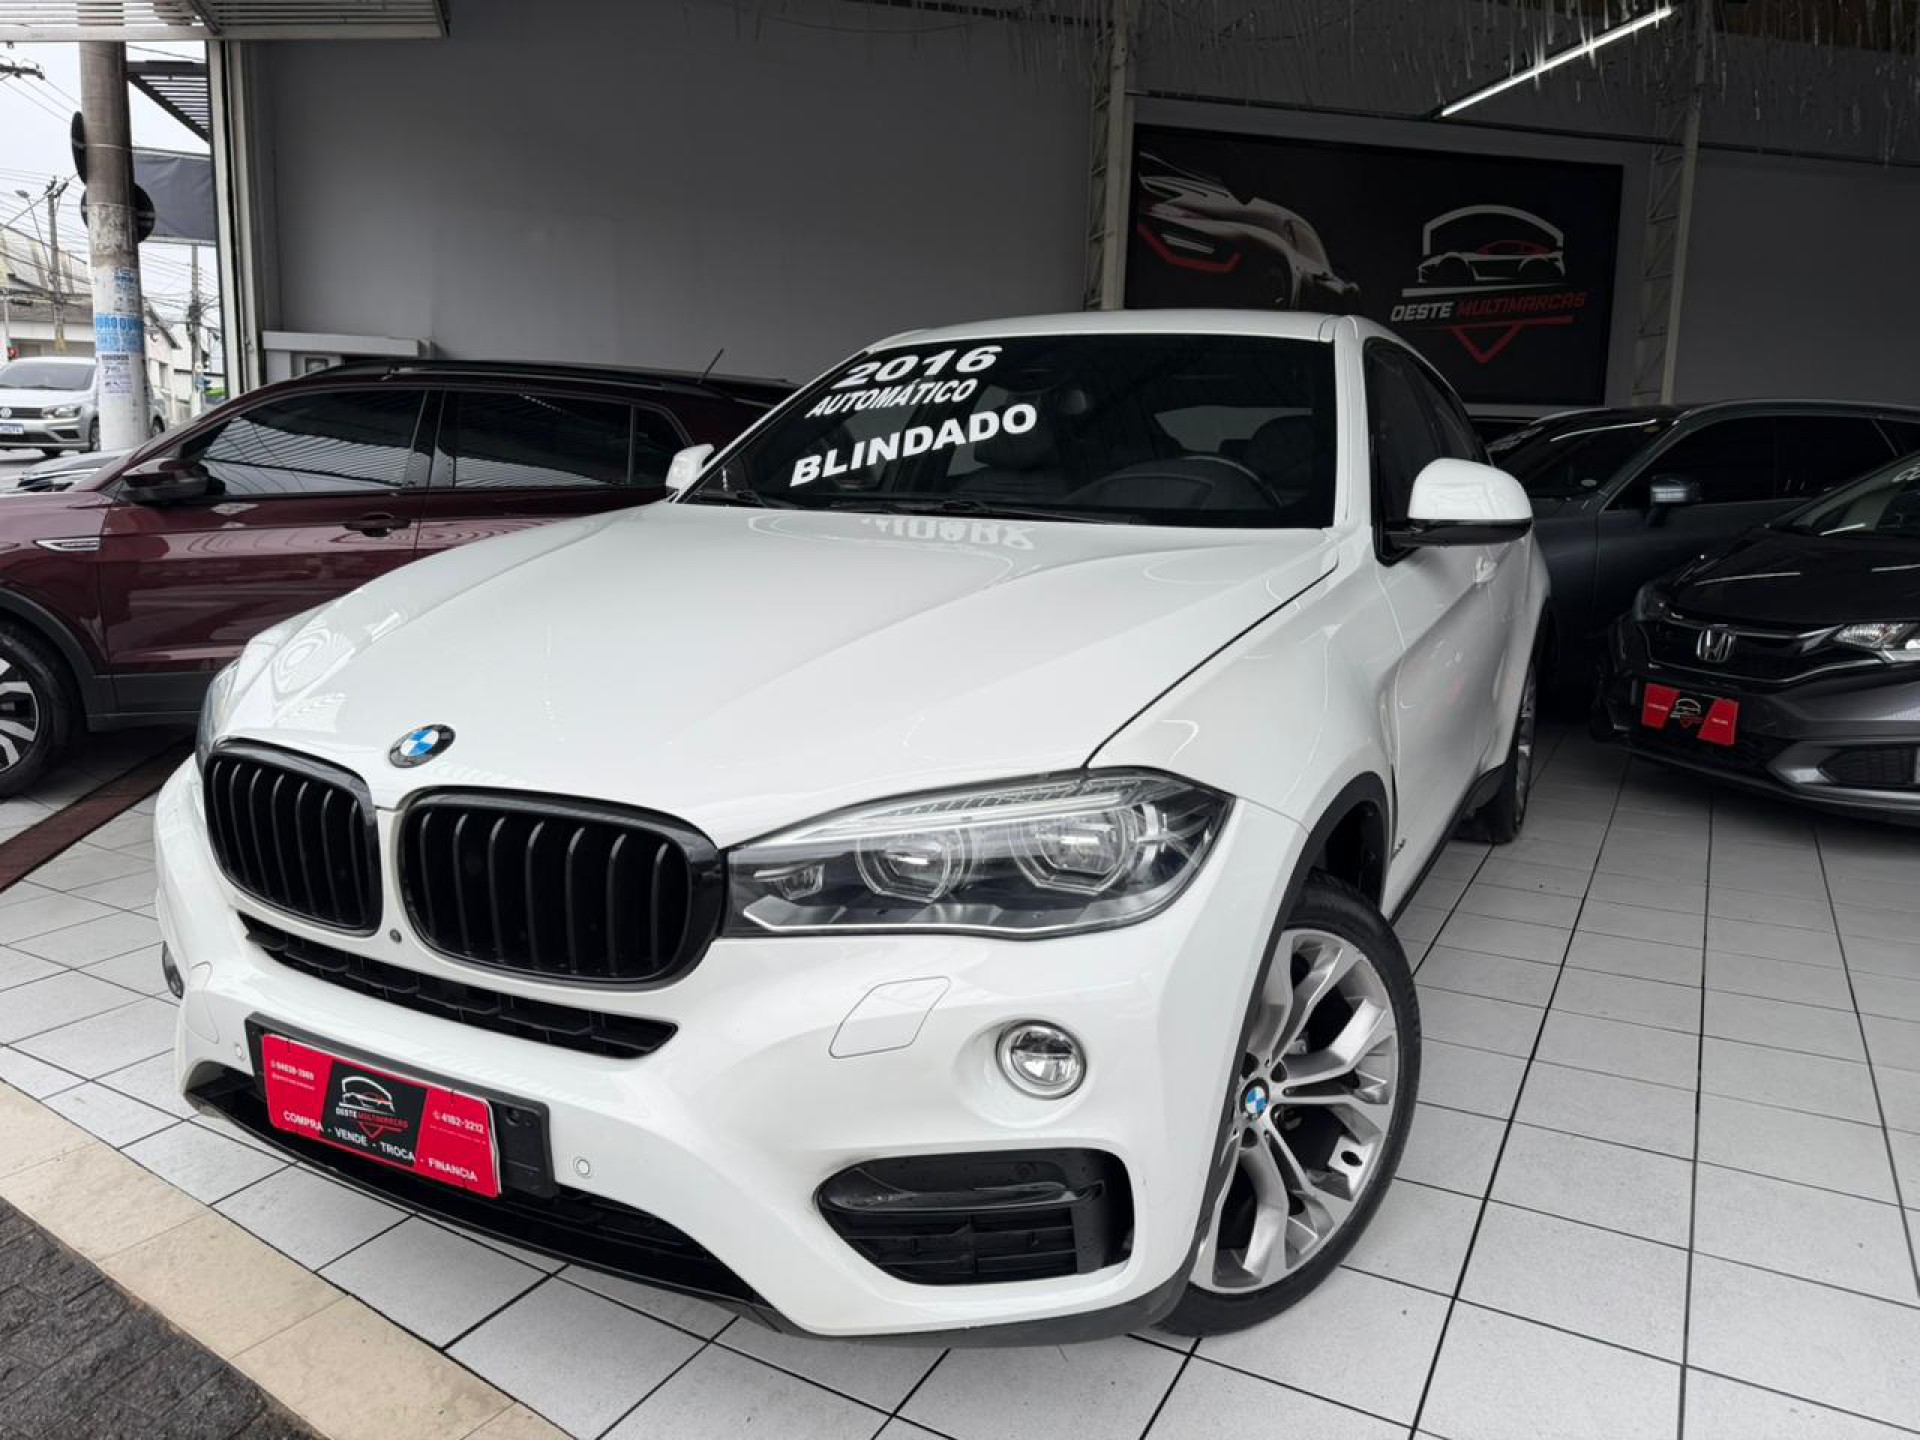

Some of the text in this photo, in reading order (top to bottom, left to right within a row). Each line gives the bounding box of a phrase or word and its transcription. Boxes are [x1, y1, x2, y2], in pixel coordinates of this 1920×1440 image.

[1389, 293, 1586, 323] OESTE MULTIMARCAS
[830, 345, 1003, 390] 2016
[804, 377, 979, 419] AUTOMÁTICO
[789, 404, 1038, 487] BLINDADO
[283, 1109, 479, 1182] COMPRA VENDE TROCA FINANCIA
